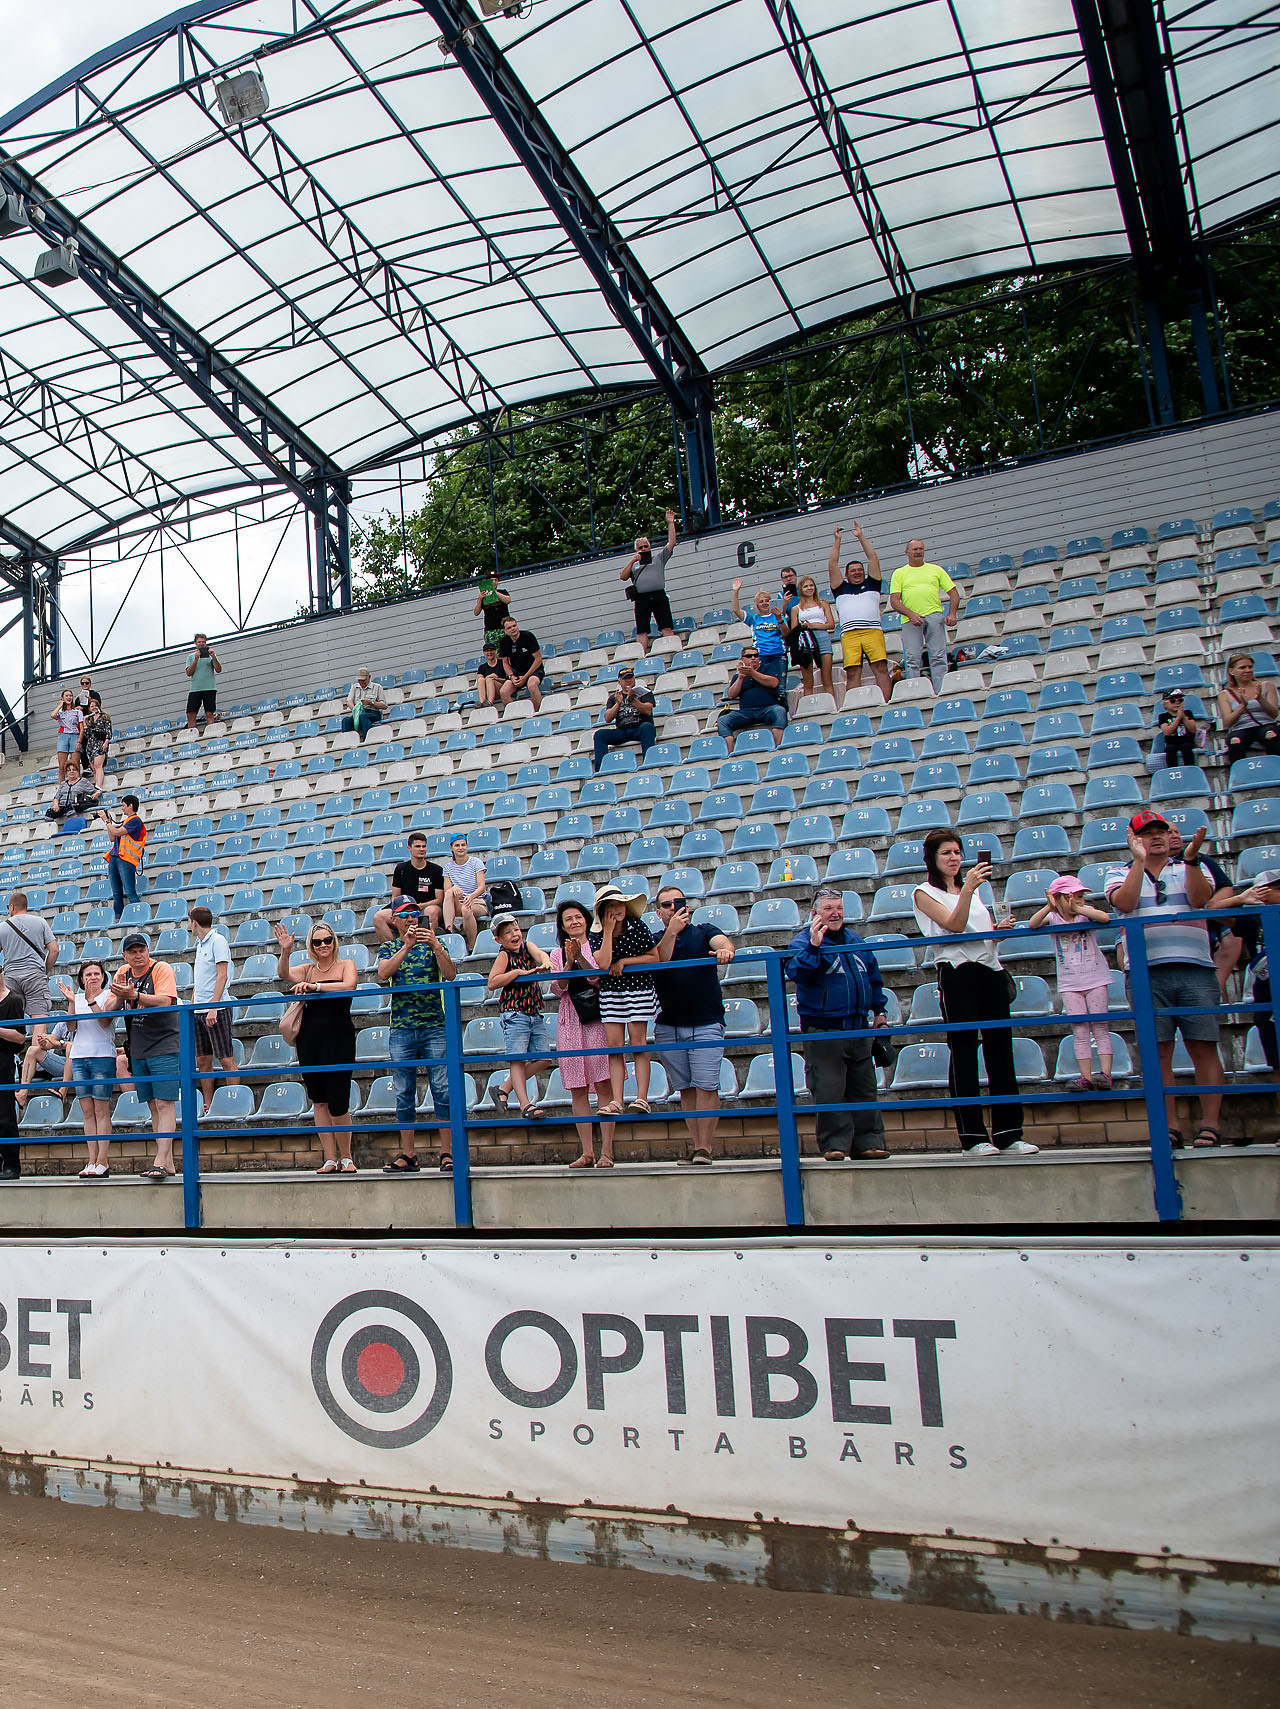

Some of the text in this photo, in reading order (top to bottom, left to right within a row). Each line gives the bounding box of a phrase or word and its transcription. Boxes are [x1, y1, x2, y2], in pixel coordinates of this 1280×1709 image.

[736, 540, 756, 568] C
[484, 1309, 957, 1428] OPTIBET
[488, 1417, 968, 1470] SPORTA BĀRS
